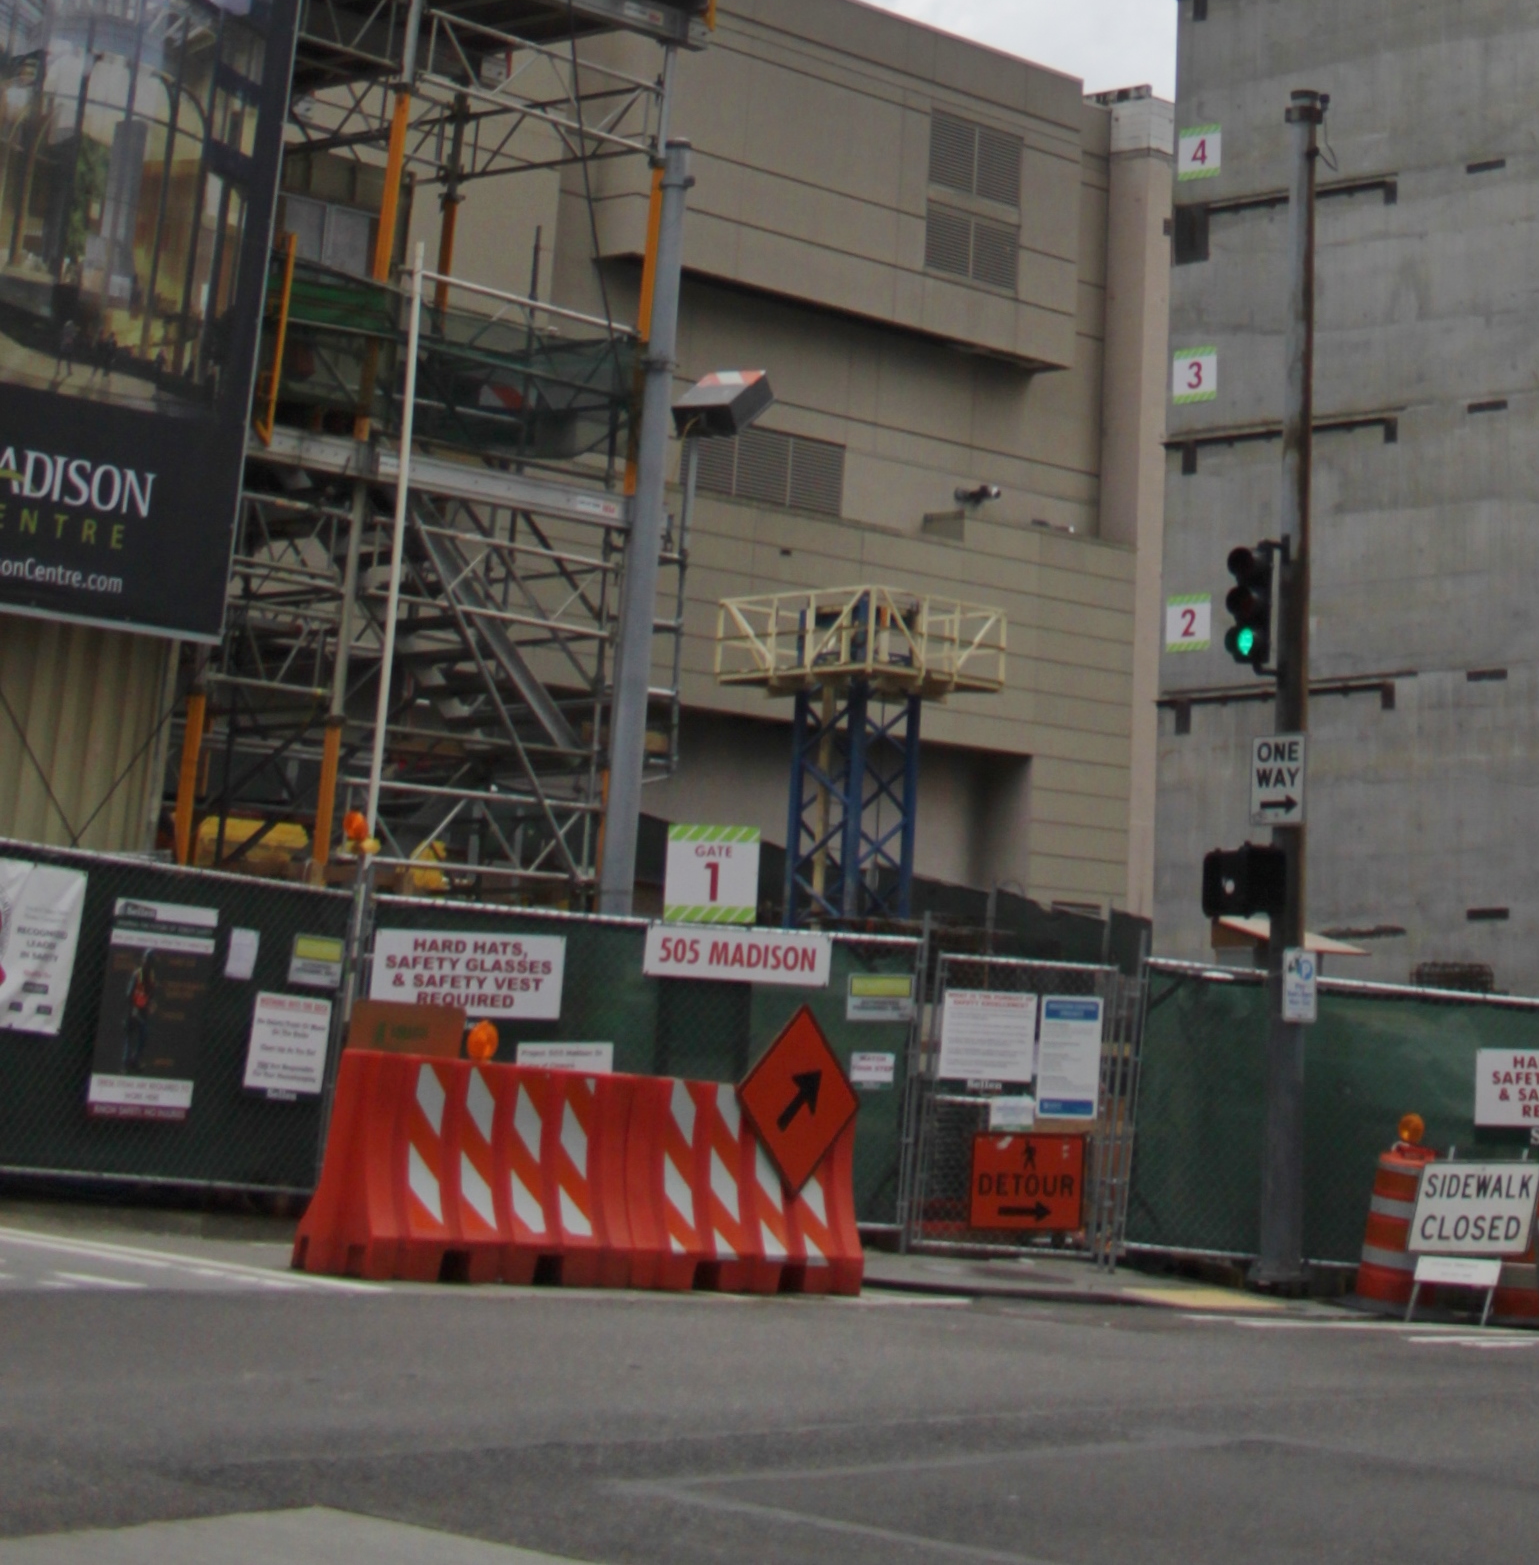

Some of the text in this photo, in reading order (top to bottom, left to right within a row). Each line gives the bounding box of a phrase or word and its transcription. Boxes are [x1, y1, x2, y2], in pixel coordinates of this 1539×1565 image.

[1191, 138, 1208, 165] 4
[1187, 361, 1202, 388] 3
[0, 557, 123, 594] onCentre.com
[1182, 608, 1196, 637] 2
[1256, 741, 1299, 762] ONE
[1256, 766, 1300, 789] WAY
[695, 844, 733, 859] GATE
[704, 861, 719, 901] 1
[413, 937, 528, 959] HARD HATS,
[658, 937, 817, 972] 505 MADISON
[385, 954, 553, 975] SAFETY GLASSES
[392, 973, 544, 992] & SAFETY VEST
[416, 991, 515, 1009] REQUIRED
[1499, 1089, 1510, 1102] &
[978, 1173, 1074, 1198] DETOUR
[1424, 1174, 1533, 1199] SIDEWALK
[1420, 1214, 1521, 1241] CLOSED
